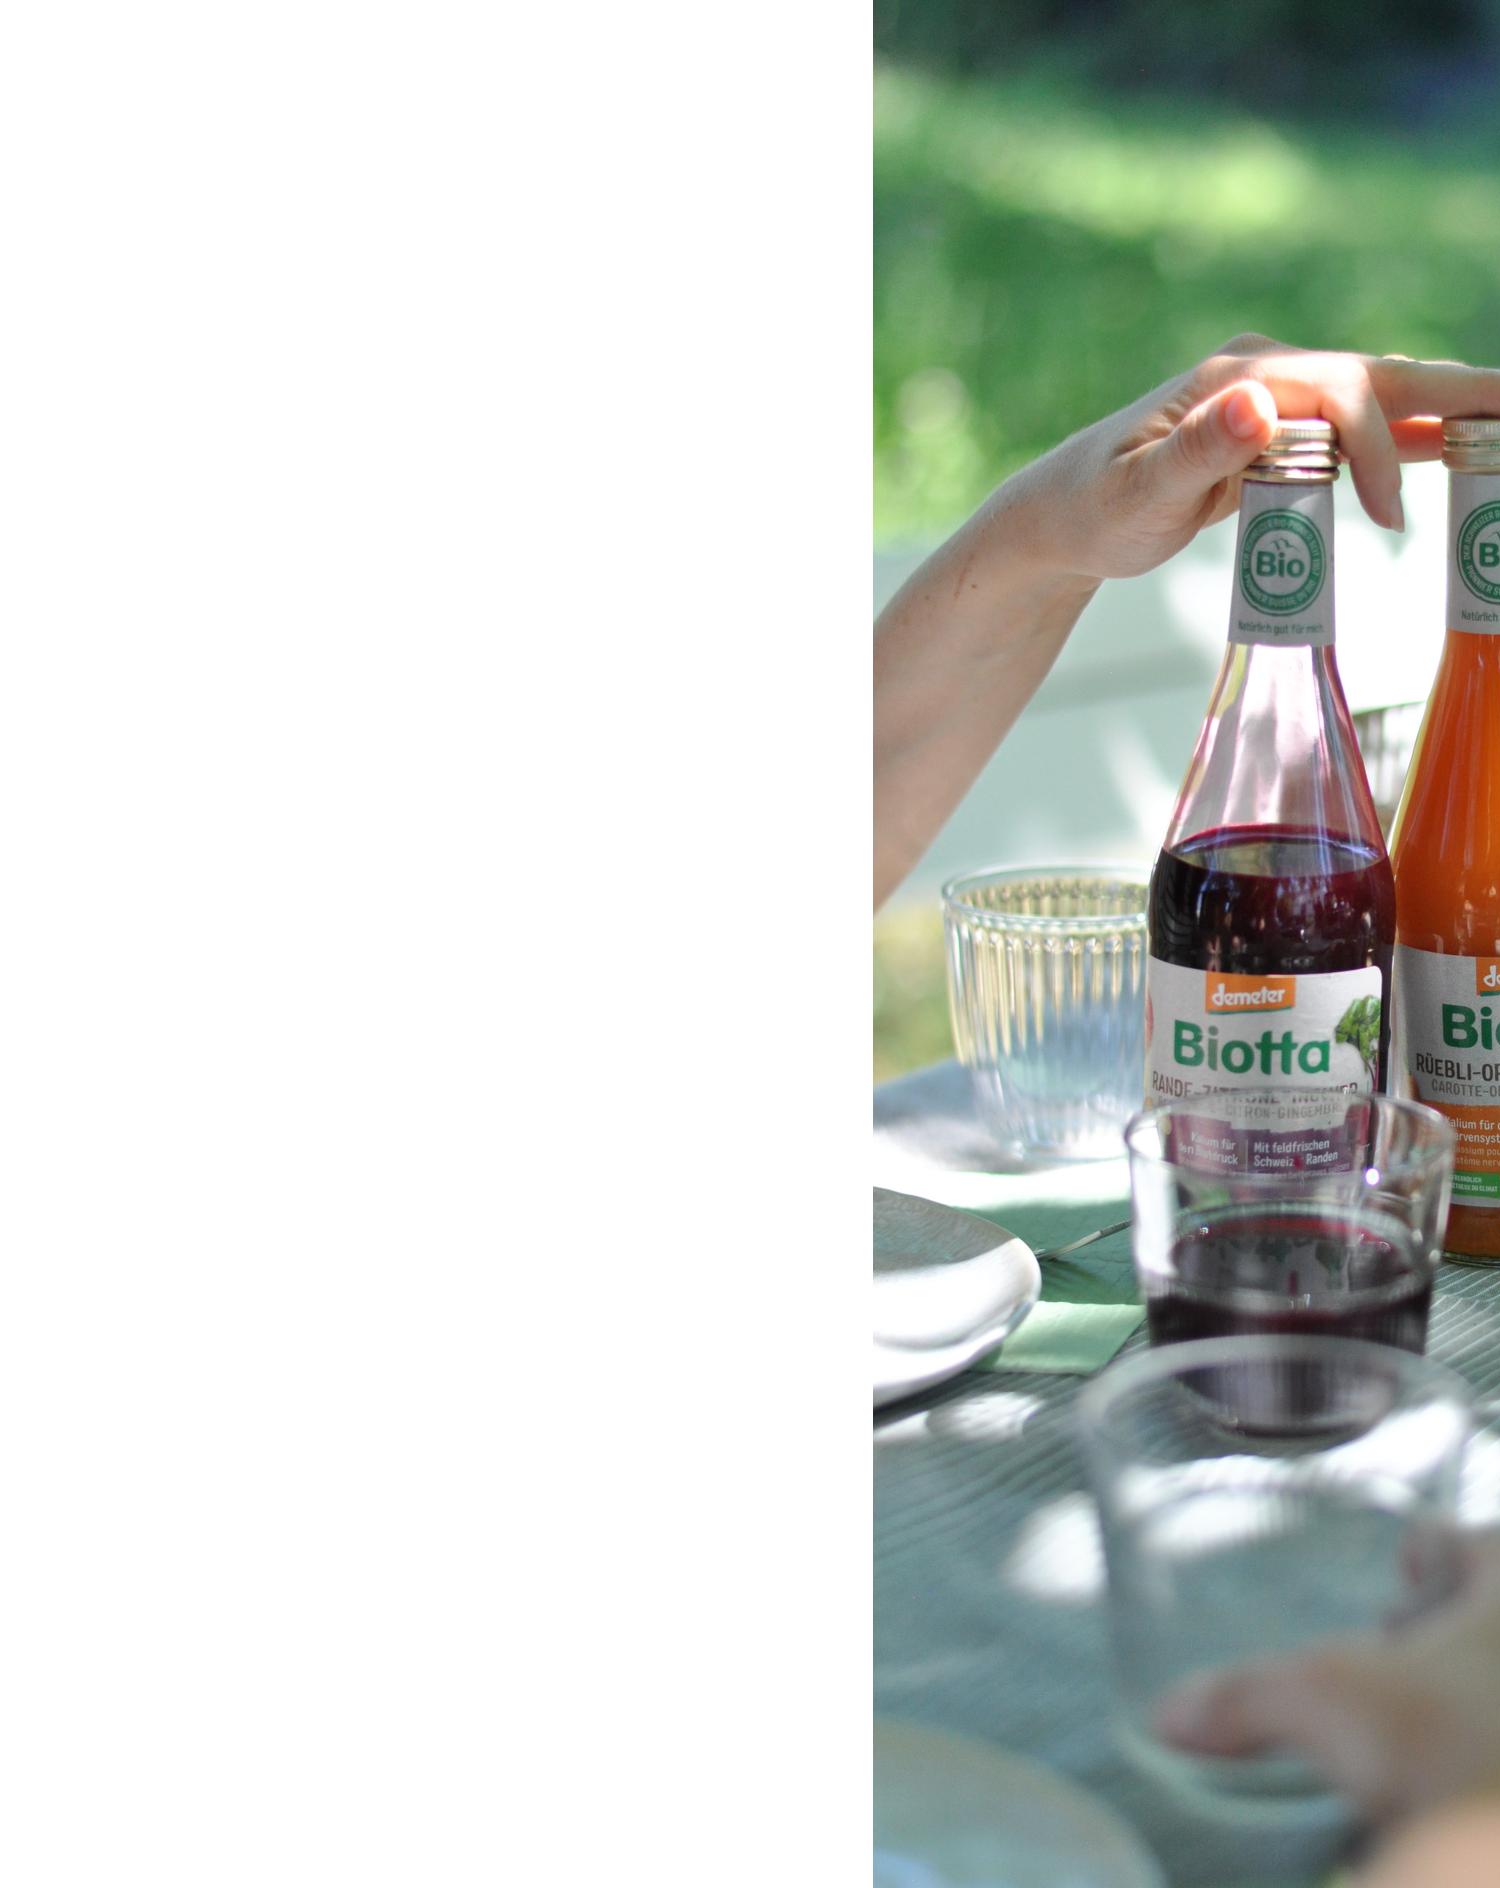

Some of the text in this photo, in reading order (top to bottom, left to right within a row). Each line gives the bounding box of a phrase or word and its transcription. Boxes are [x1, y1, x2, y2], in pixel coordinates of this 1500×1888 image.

[1256, 551, 1305, 578] Bio
[1273, 624, 1288, 636] gut
[1212, 983, 1286, 1007] demeter
[1174, 1019, 1331, 1075] Biotta
[1479, 1119, 1494, 1131] für
[1220, 1138, 1237, 1150] für
[1254, 1139, 1330, 1153] Mit feldfrischen
[1254, 1150, 1339, 1168] Schweiz Randen
